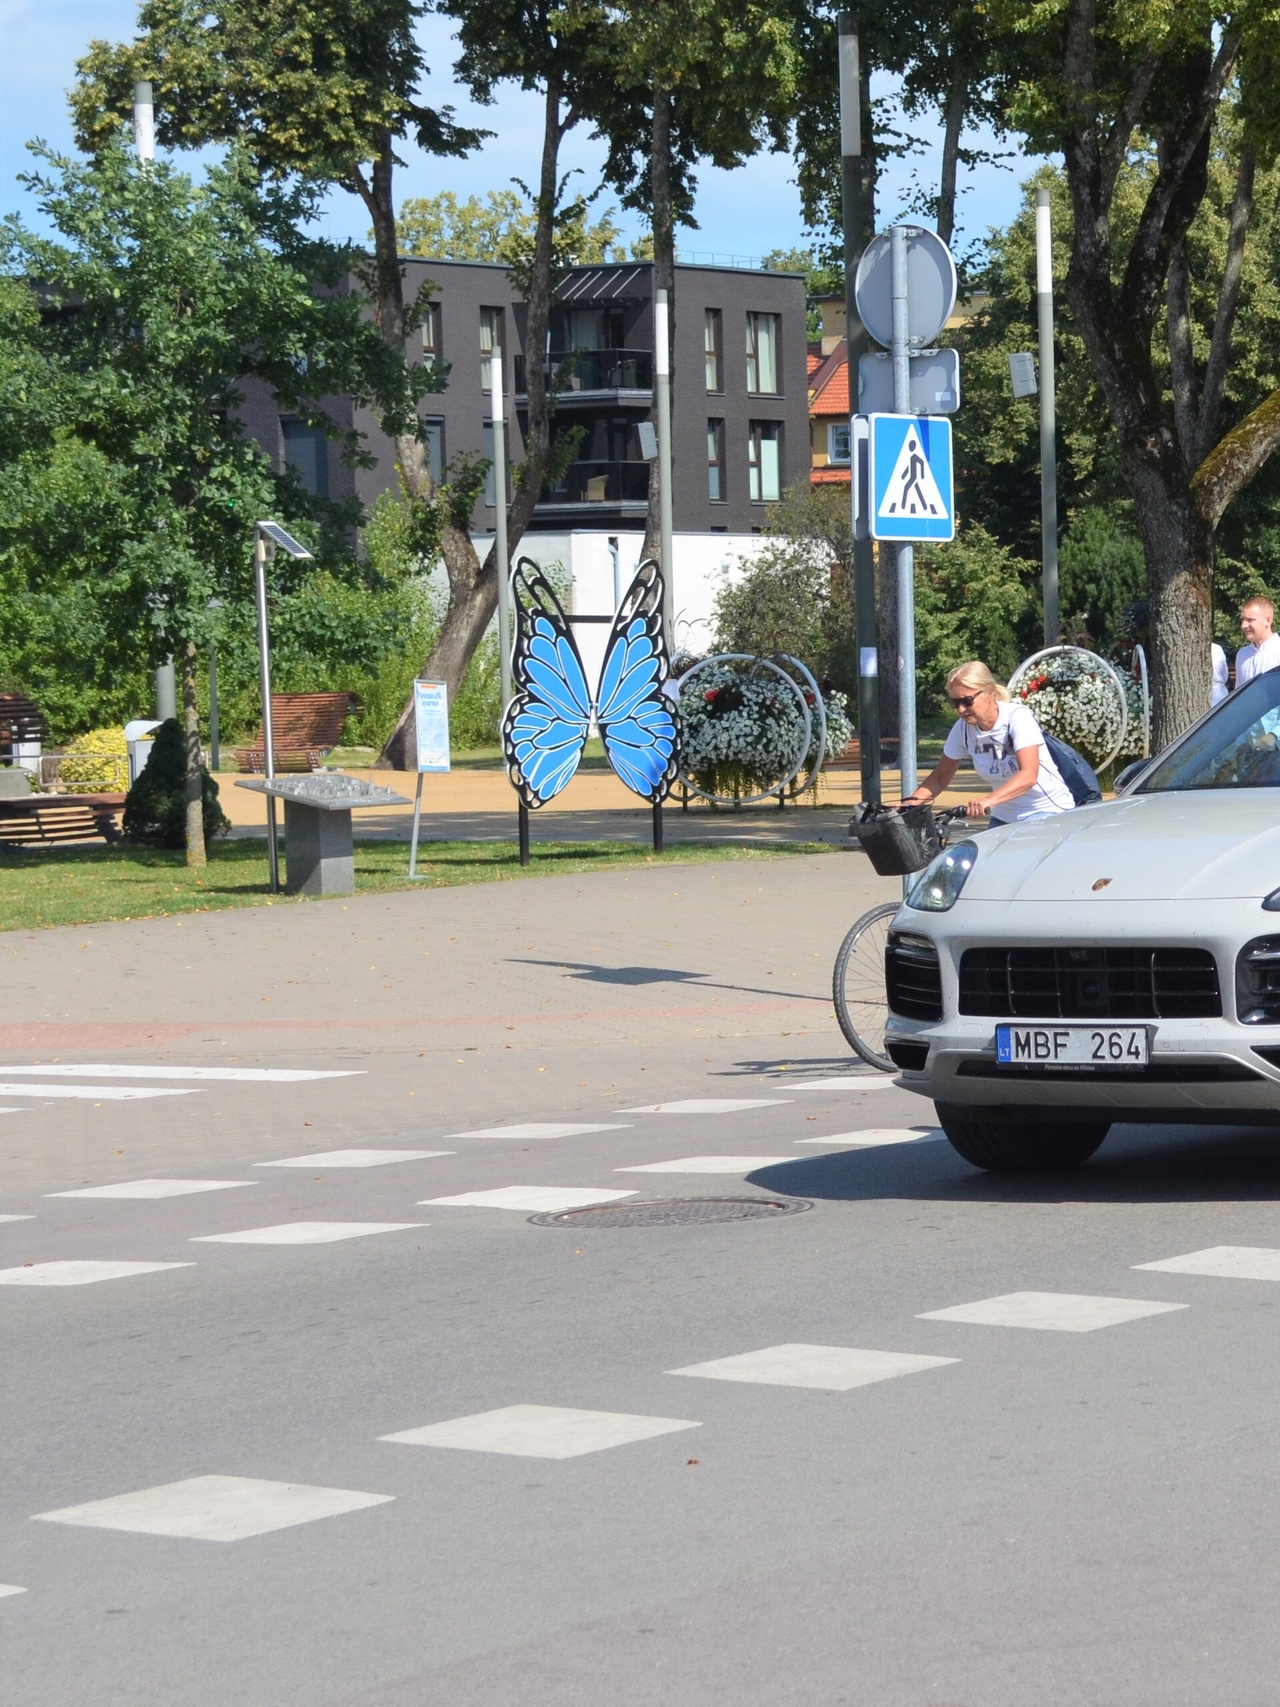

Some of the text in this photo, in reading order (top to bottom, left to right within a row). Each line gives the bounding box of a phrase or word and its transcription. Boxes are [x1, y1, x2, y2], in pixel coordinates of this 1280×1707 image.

[999, 1048, 1010, 1057] LT
[1014, 1031, 1141, 1059] MBF 264
